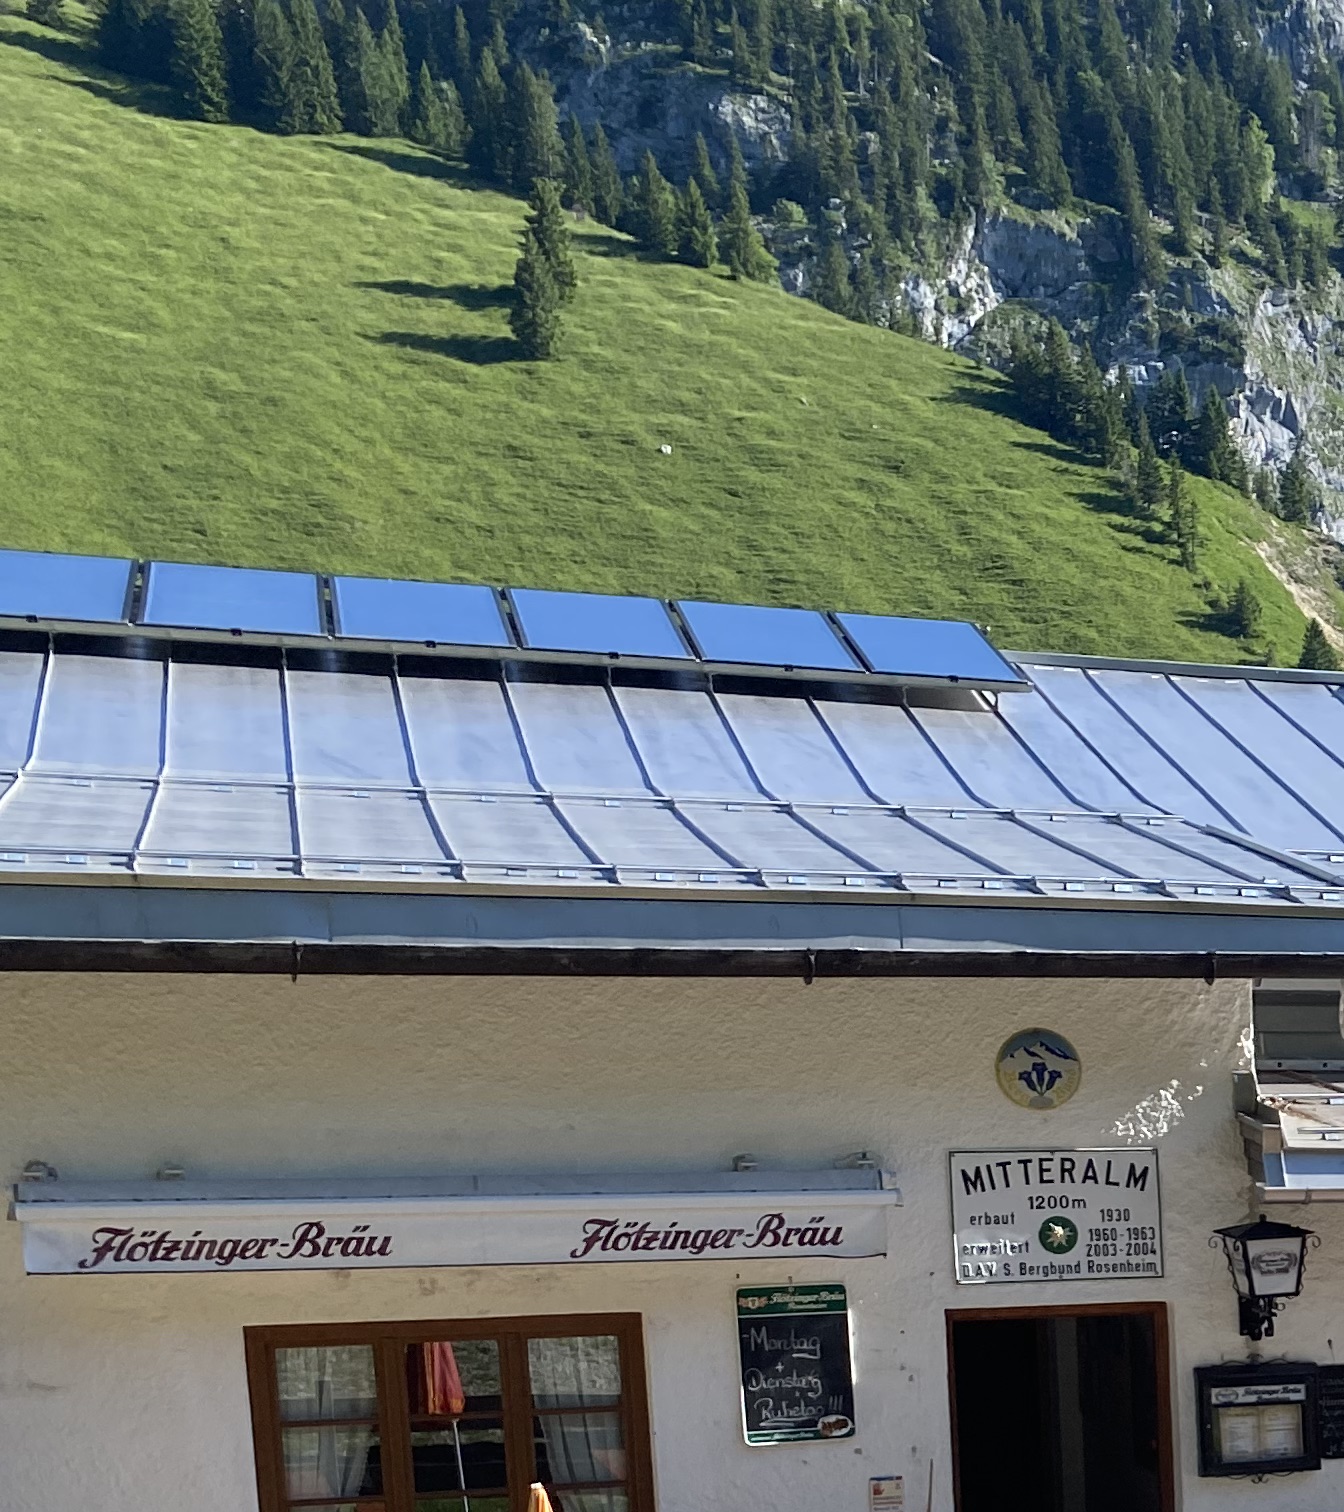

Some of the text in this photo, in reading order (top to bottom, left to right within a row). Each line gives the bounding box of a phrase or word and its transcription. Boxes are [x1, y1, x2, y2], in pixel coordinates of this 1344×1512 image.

[960, 1157, 1149, 1195] MITTERALM
[1028, 1195, 1086, 1210] 1200m
[969, 1208, 1131, 1225] erbaut 1930
[962, 1239, 1029, 1255] erweitert
[1003, 1262, 1015, 1276] S.
[1020, 1260, 1081, 1277] Bergbund
[1087, 1258, 1157, 1274] Rosenheim
